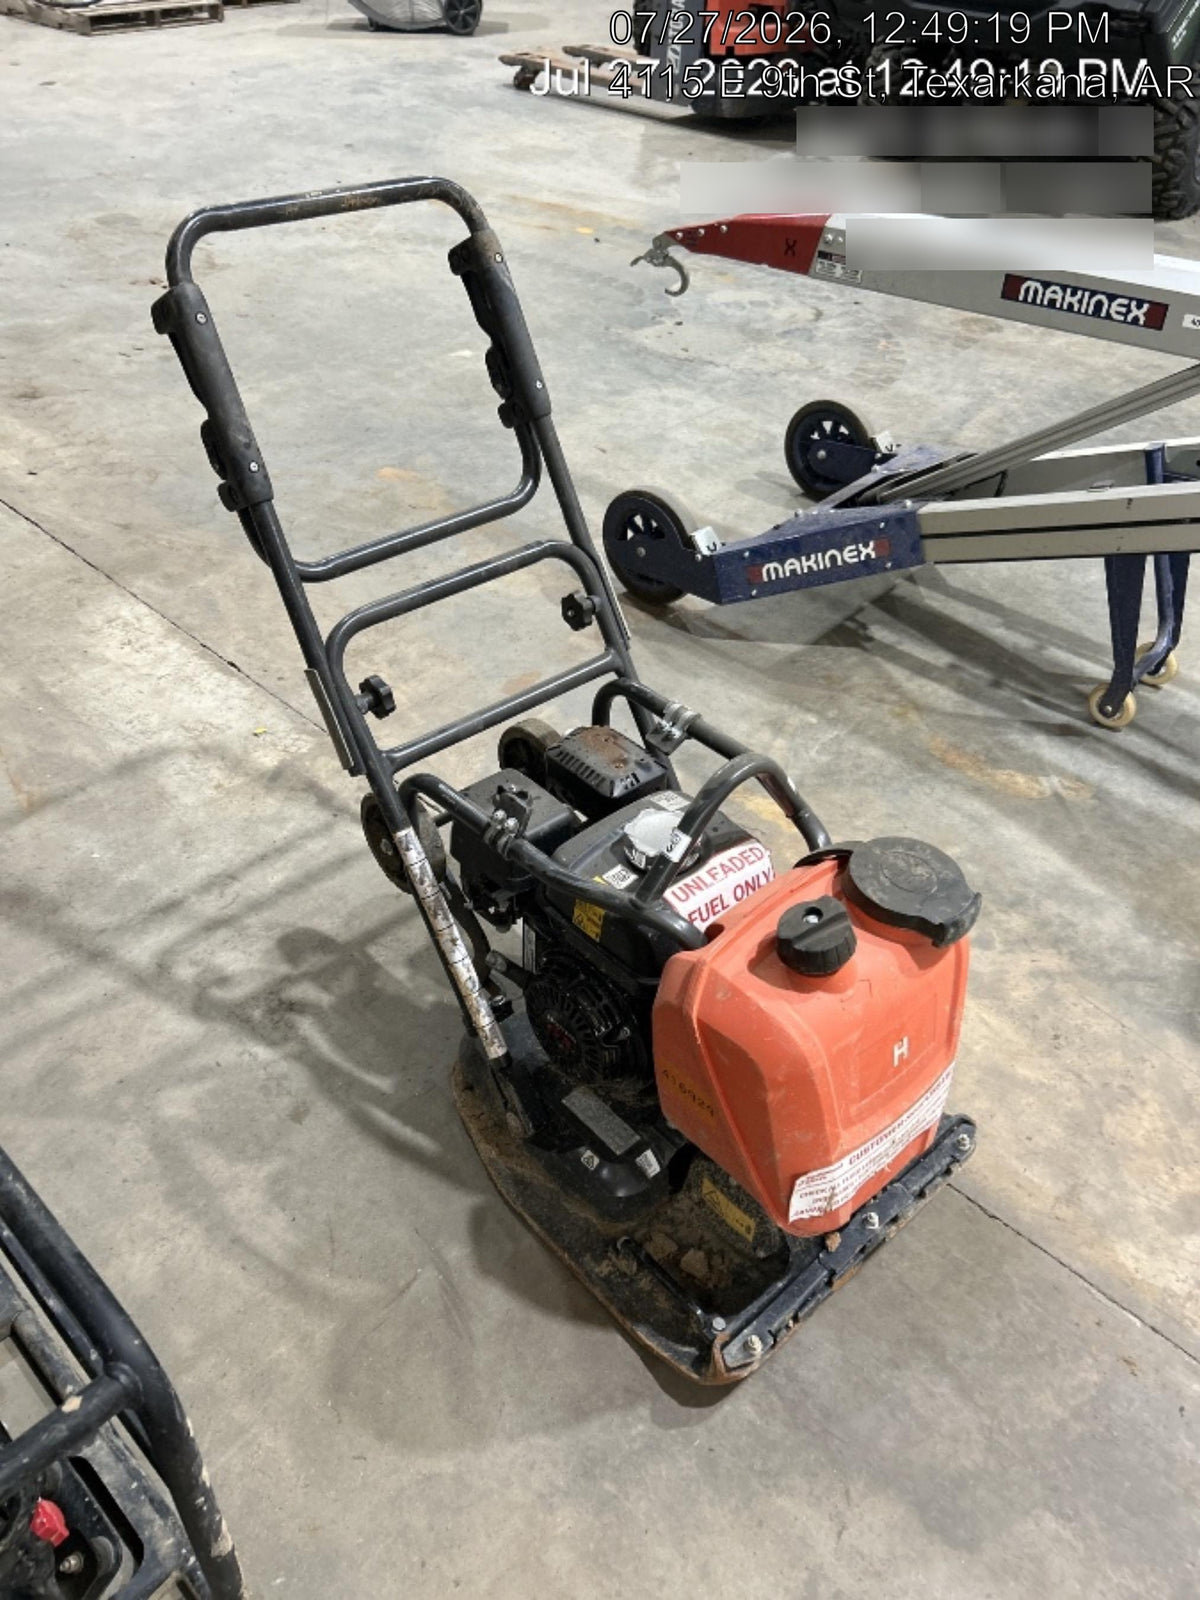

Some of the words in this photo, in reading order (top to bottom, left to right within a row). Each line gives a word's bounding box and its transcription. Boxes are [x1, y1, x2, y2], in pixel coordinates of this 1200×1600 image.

[1018, 280, 1150, 327] MAKINEX
[762, 540, 876, 582] MAKINEX
[671, 847, 764, 902] UNLEADED
[687, 894, 730, 924] FUEL
[733, 867, 771, 902] ONLY
